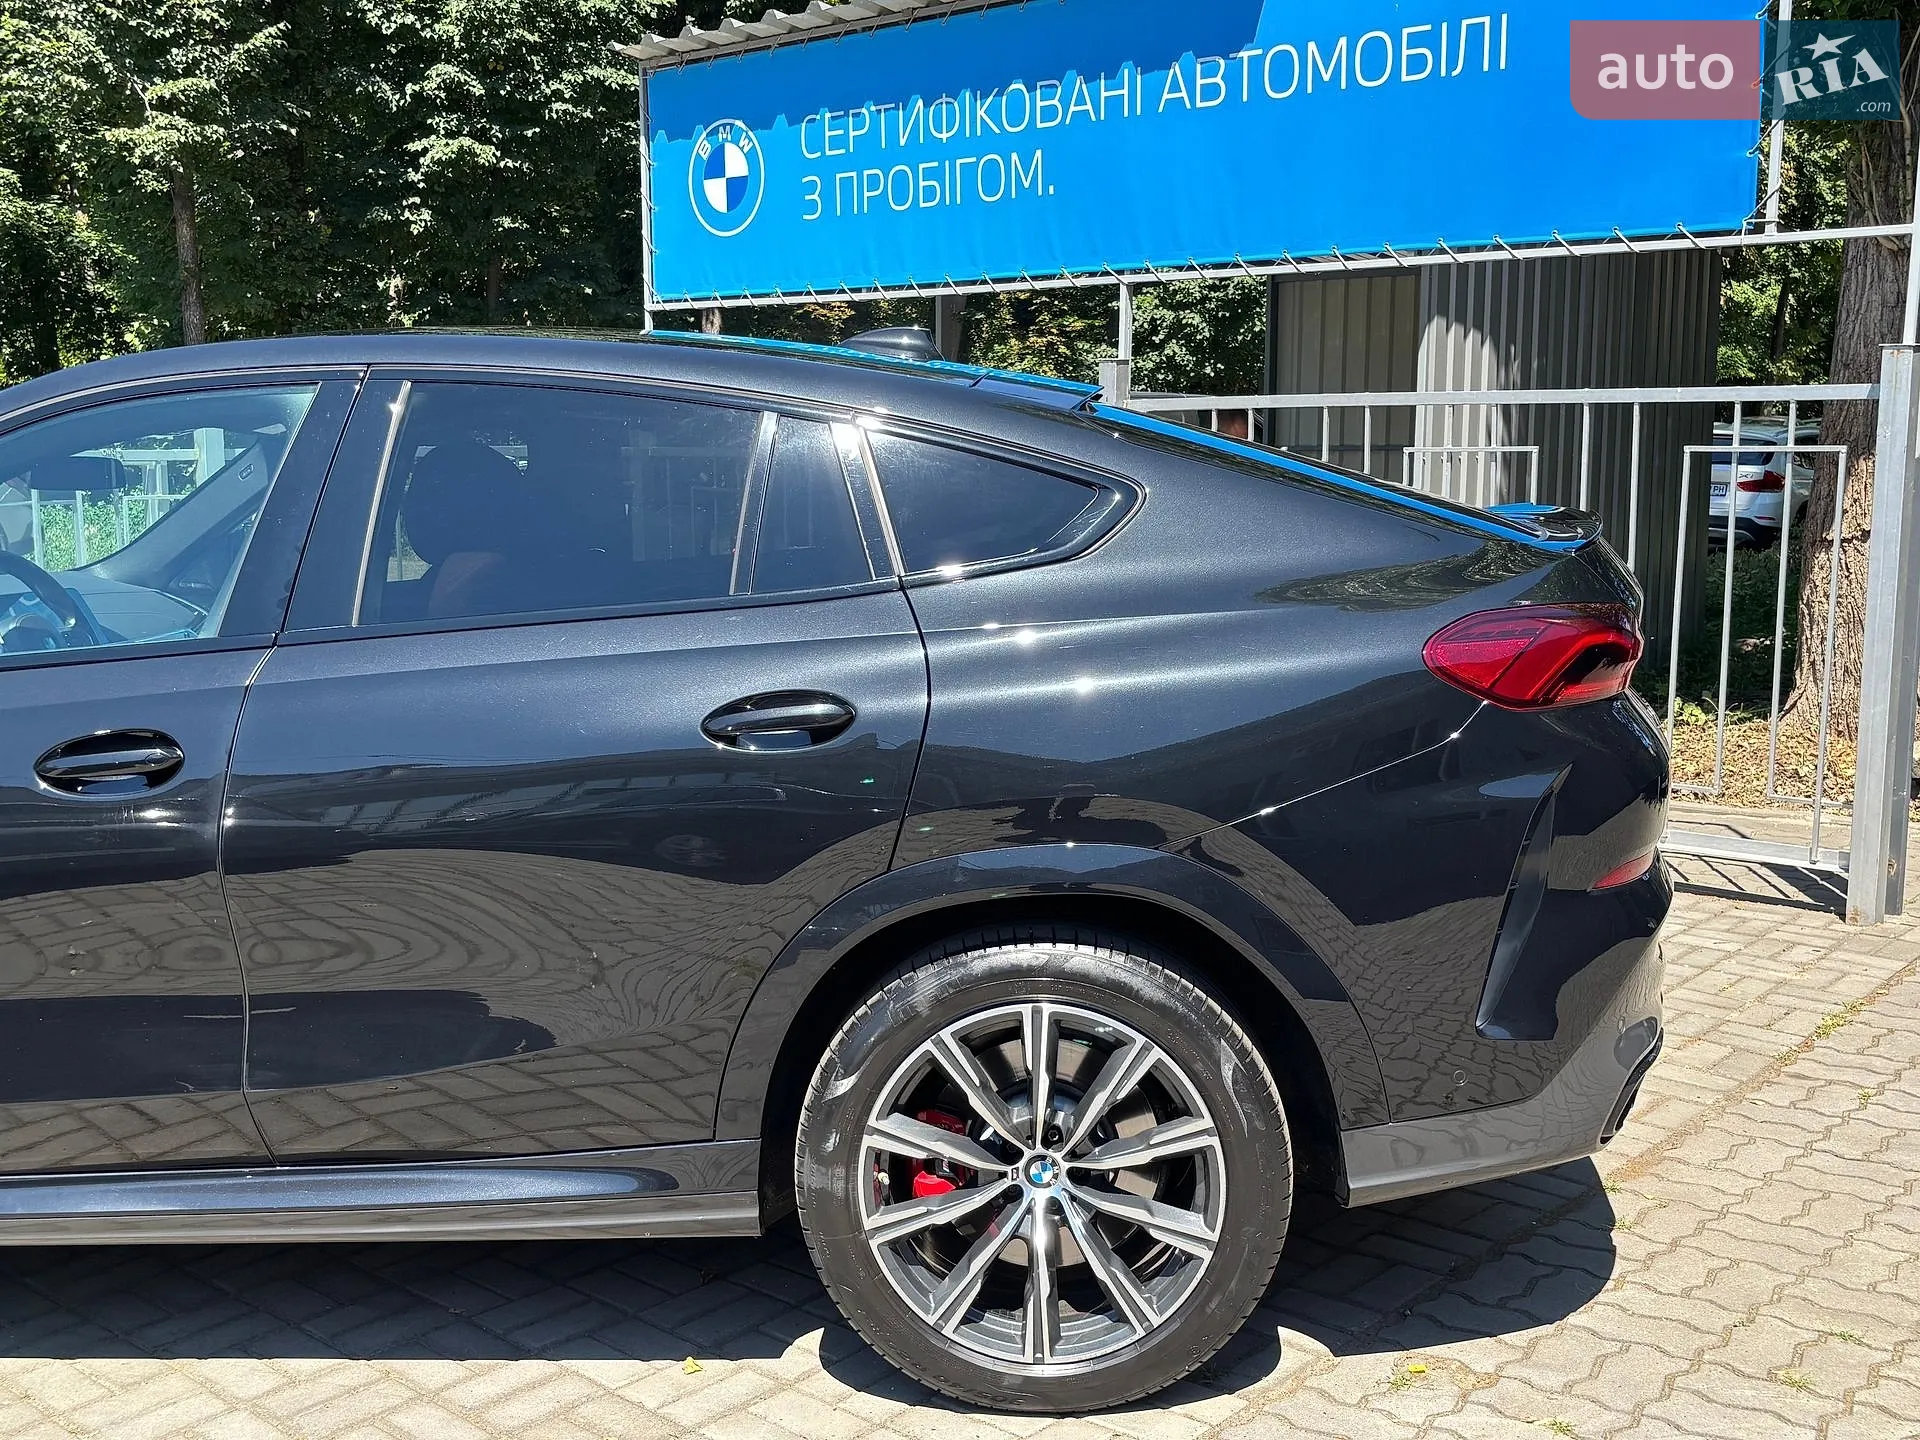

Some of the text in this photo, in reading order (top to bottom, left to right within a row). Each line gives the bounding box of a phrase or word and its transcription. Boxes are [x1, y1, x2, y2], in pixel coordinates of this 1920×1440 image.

[800, 13, 1509, 160] СЕРТИФІКОВАНІ АВТОМОБІЛІ
[697, 125, 755, 161] BMW
[835, 148, 1055, 217] ПРОБІГОМ.
